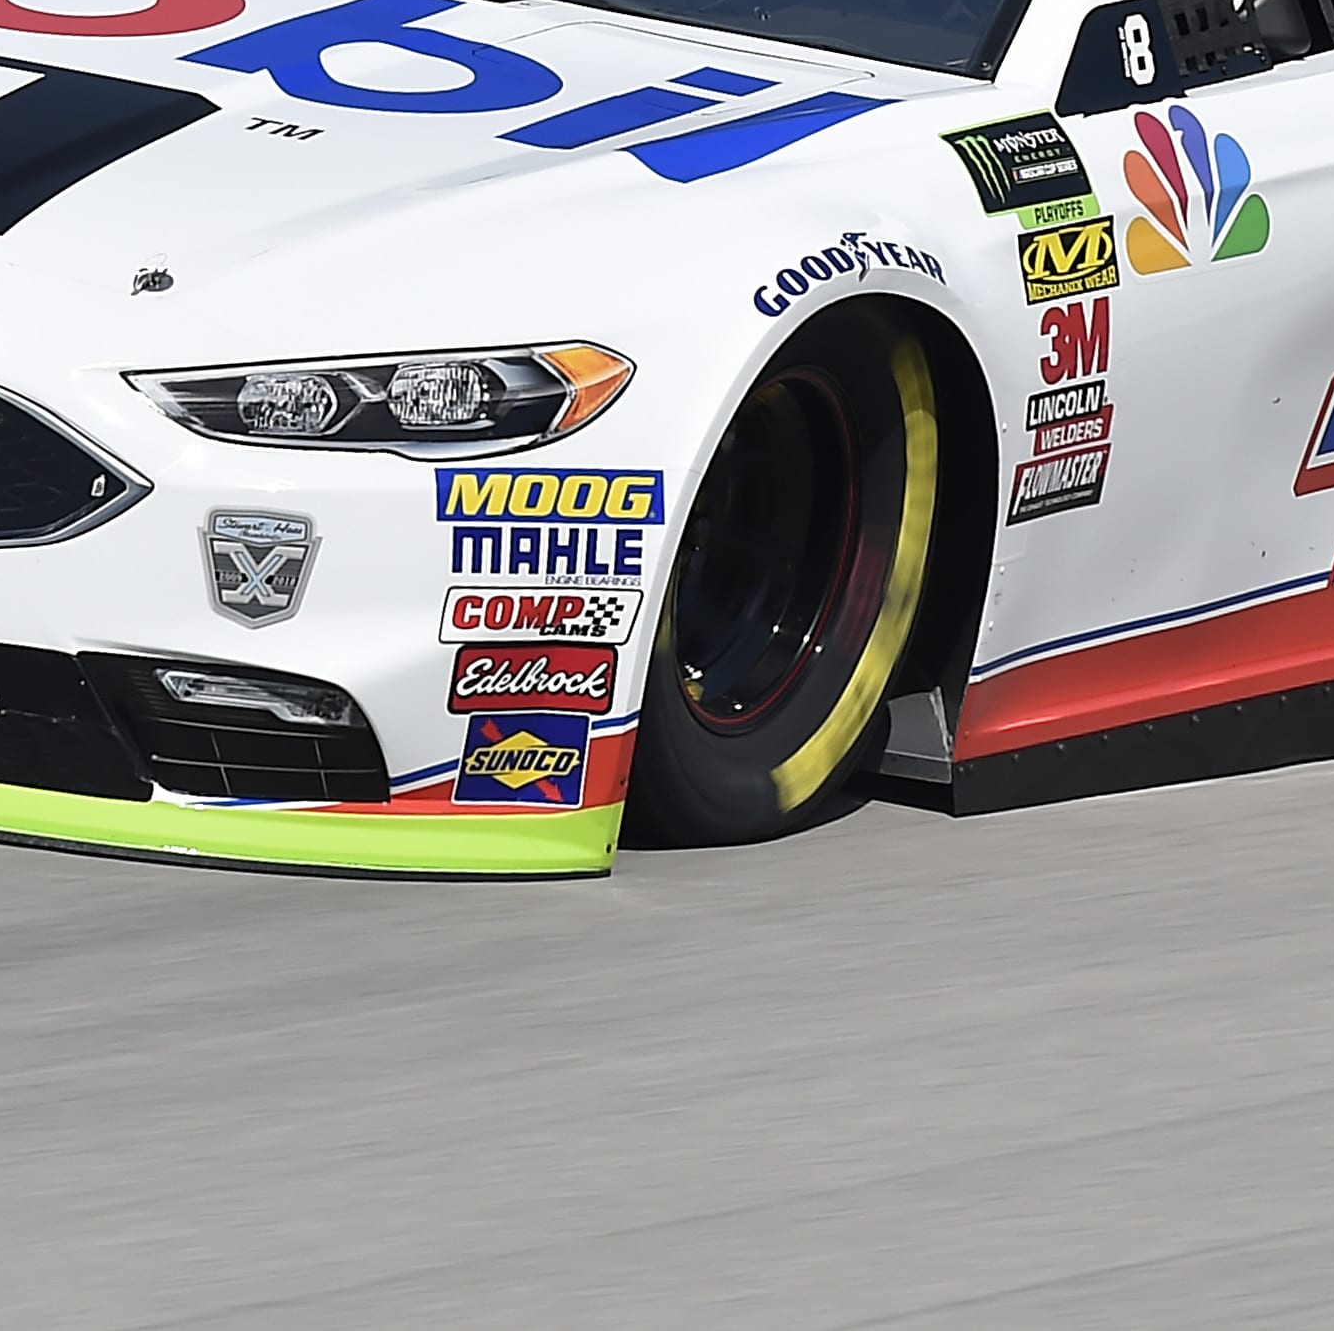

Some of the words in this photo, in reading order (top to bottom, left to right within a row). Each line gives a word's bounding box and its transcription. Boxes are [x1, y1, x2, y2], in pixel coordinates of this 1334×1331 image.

[244, 116, 326, 141] TM
[1034, 199, 1084, 225] PLAYOFFS
[1084, 264, 1117, 289] WEAR
[1040, 297, 1110, 386] 3M
[1029, 384, 1101, 426] LINCOLN
[1041, 417, 1104, 451] WELDERS
[445, 472, 656, 519] MOOG
[1012, 451, 1104, 516] FLOWMASTER
[452, 526, 643, 576] MAHLE
[452, 594, 586, 631] COMP
[538, 623, 608, 638] CAMS
[455, 655, 611, 698] Edelbrock
[467, 748, 576, 774] SUNOCO
